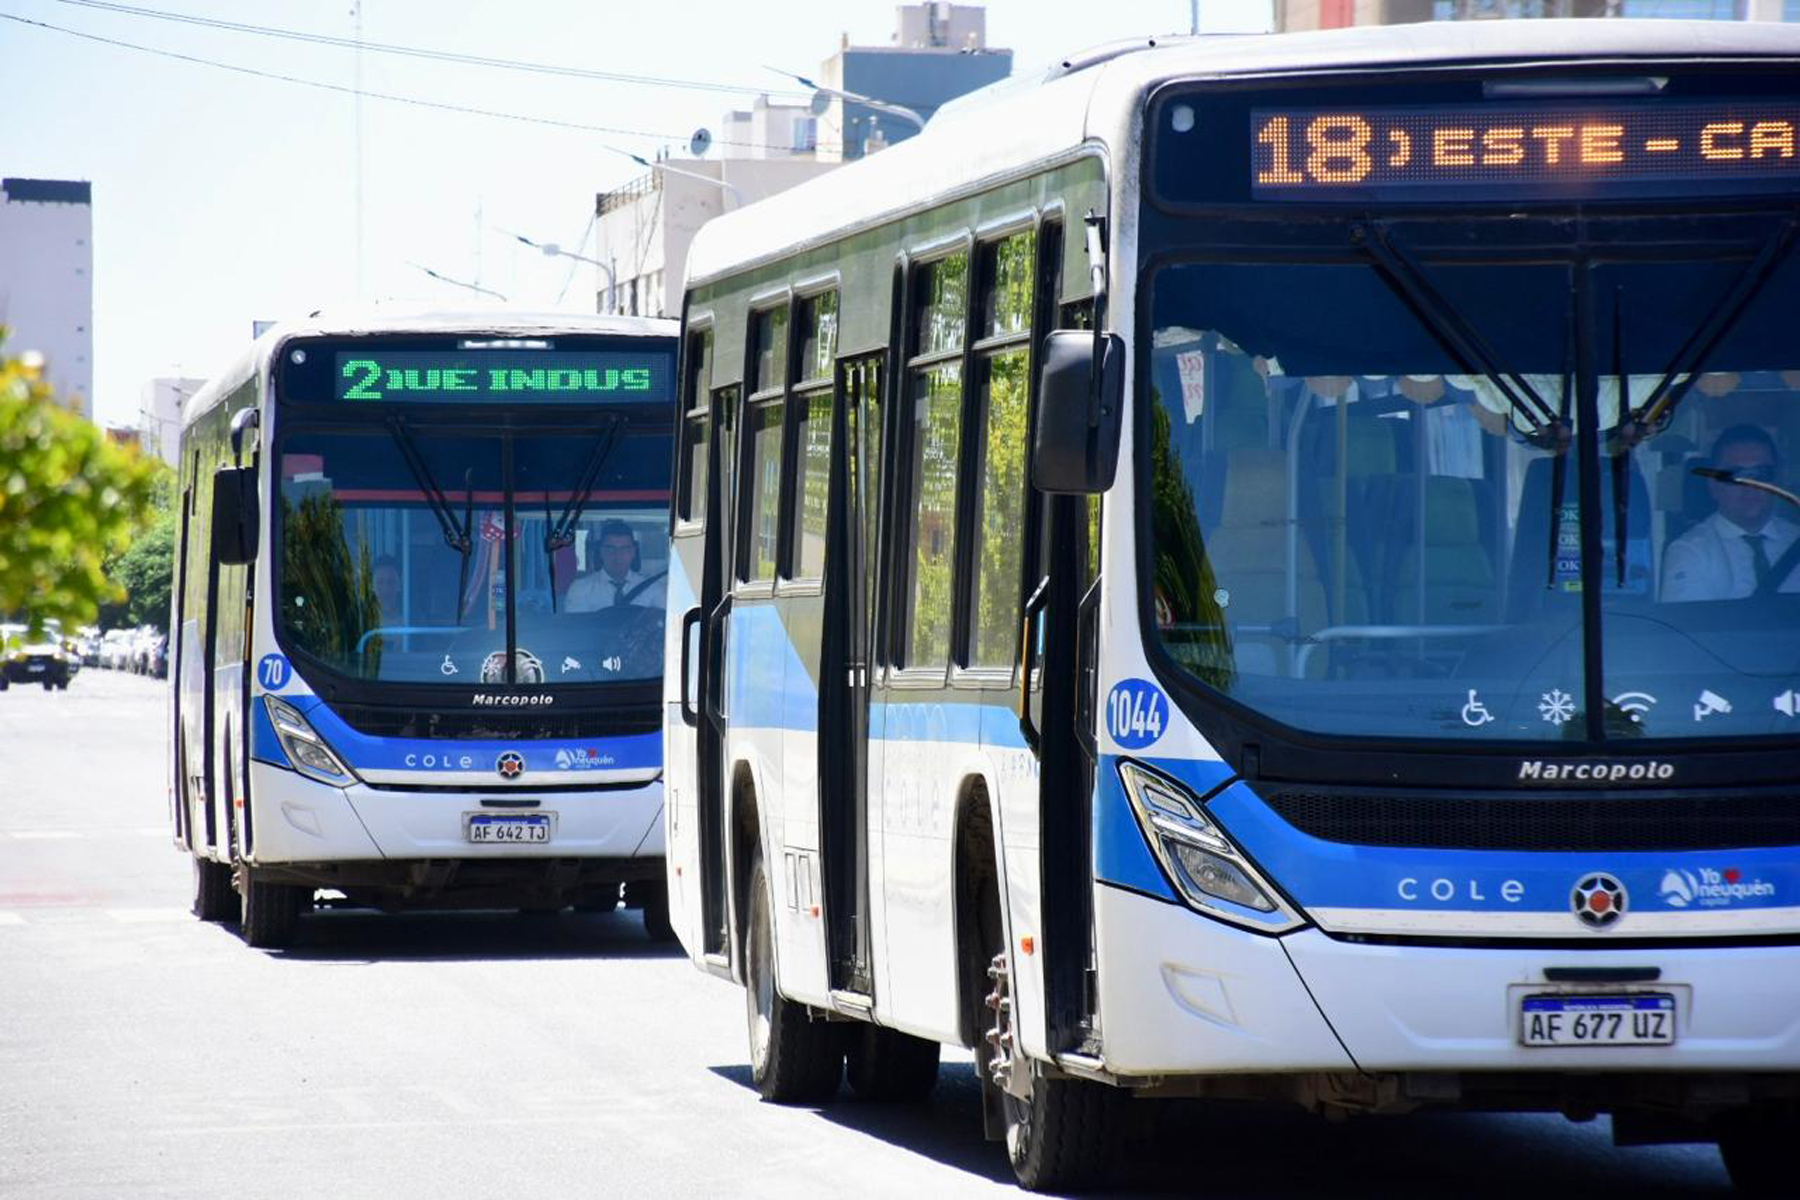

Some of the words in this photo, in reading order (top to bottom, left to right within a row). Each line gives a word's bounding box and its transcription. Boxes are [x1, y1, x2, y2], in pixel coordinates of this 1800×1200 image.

[1259, 116, 1372, 183] 18
[1434, 126, 1624, 166] ESTE
[1700, 122, 1794, 159] CA
[342, 360, 382, 399] 2
[489, 369, 649, 390] INDUS
[1557, 560, 1580, 571] OK
[264, 659, 283, 685] 70
[472, 694, 554, 707] Marcopolo
[1110, 689, 1161, 738] 1044
[1518, 761, 1675, 780] Marcopolo
[474, 826, 491, 839] AF
[496, 825, 523, 839] 642
[1699, 867, 1720, 884] Yo
[1530, 1014, 1562, 1040] AF
[1573, 1013, 1622, 1039] 677
[1633, 1013, 1666, 1039] UZ
